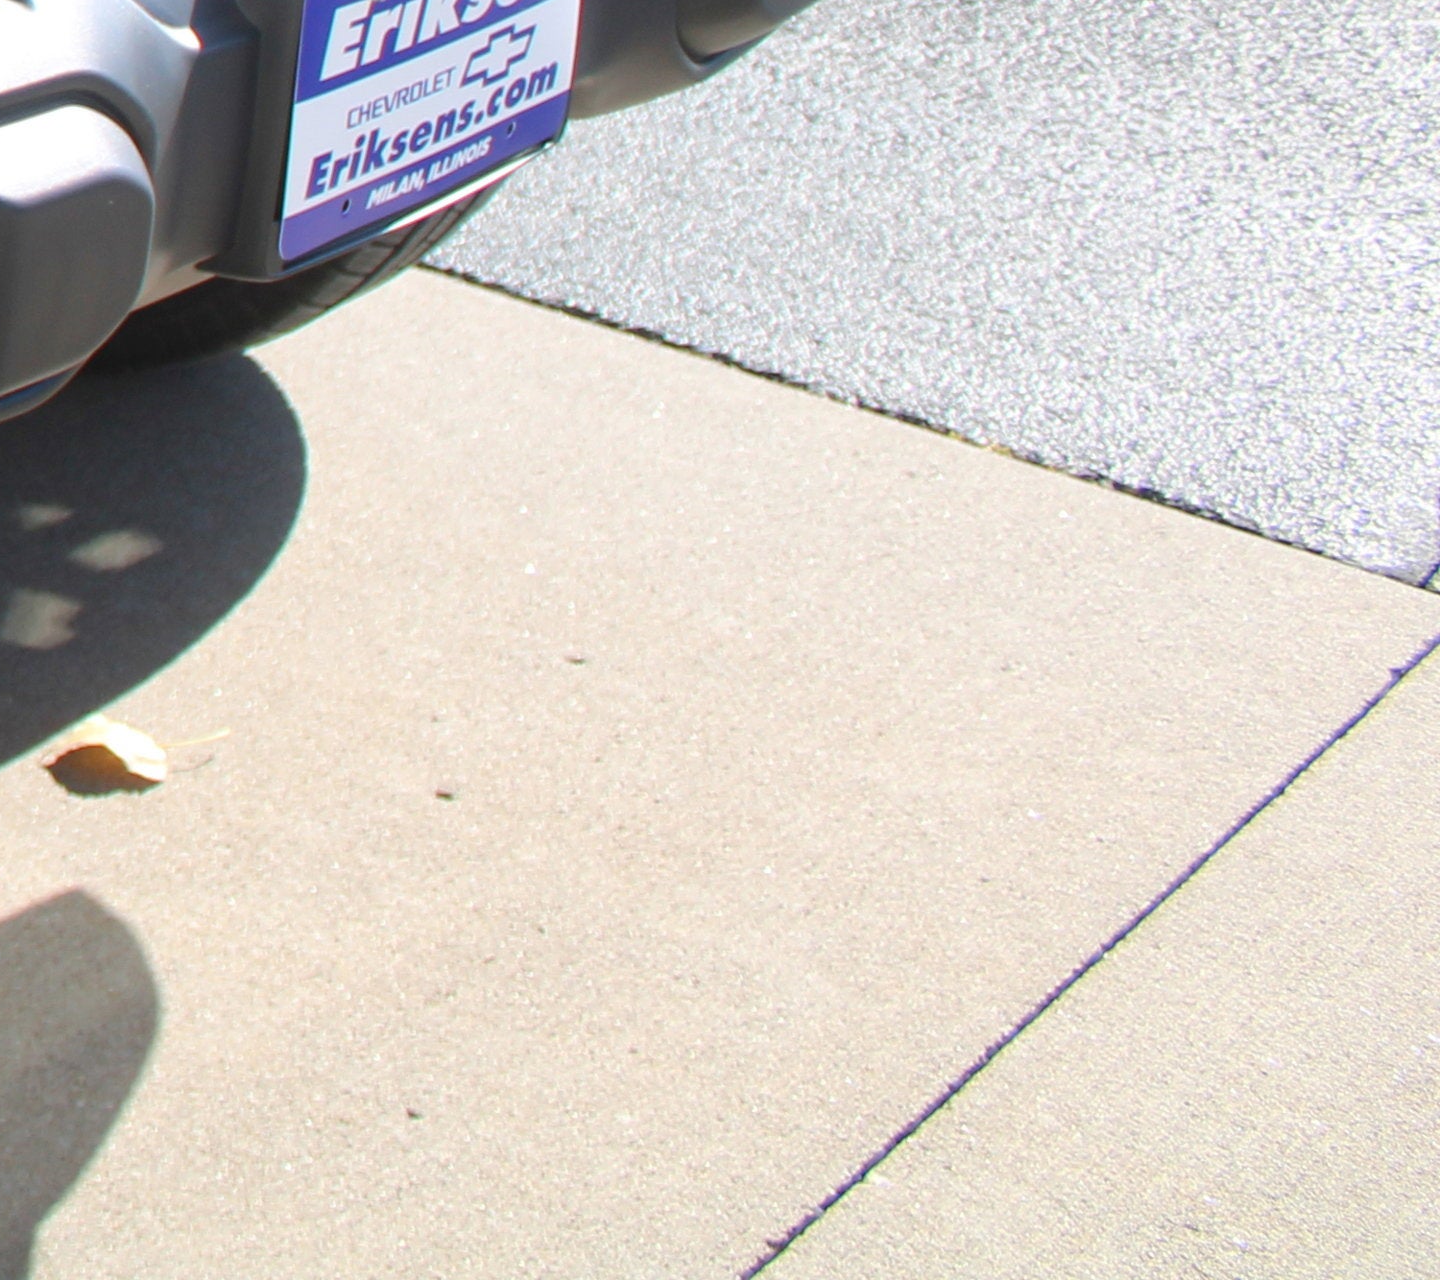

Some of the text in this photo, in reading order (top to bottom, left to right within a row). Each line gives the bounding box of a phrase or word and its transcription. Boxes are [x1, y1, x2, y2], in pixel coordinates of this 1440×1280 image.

[304, 60, 558, 200] Eriksens.com
[346, 66, 456, 129] CHEVROLET
[365, 136, 492, 210] MILAN, ILLINOIS
